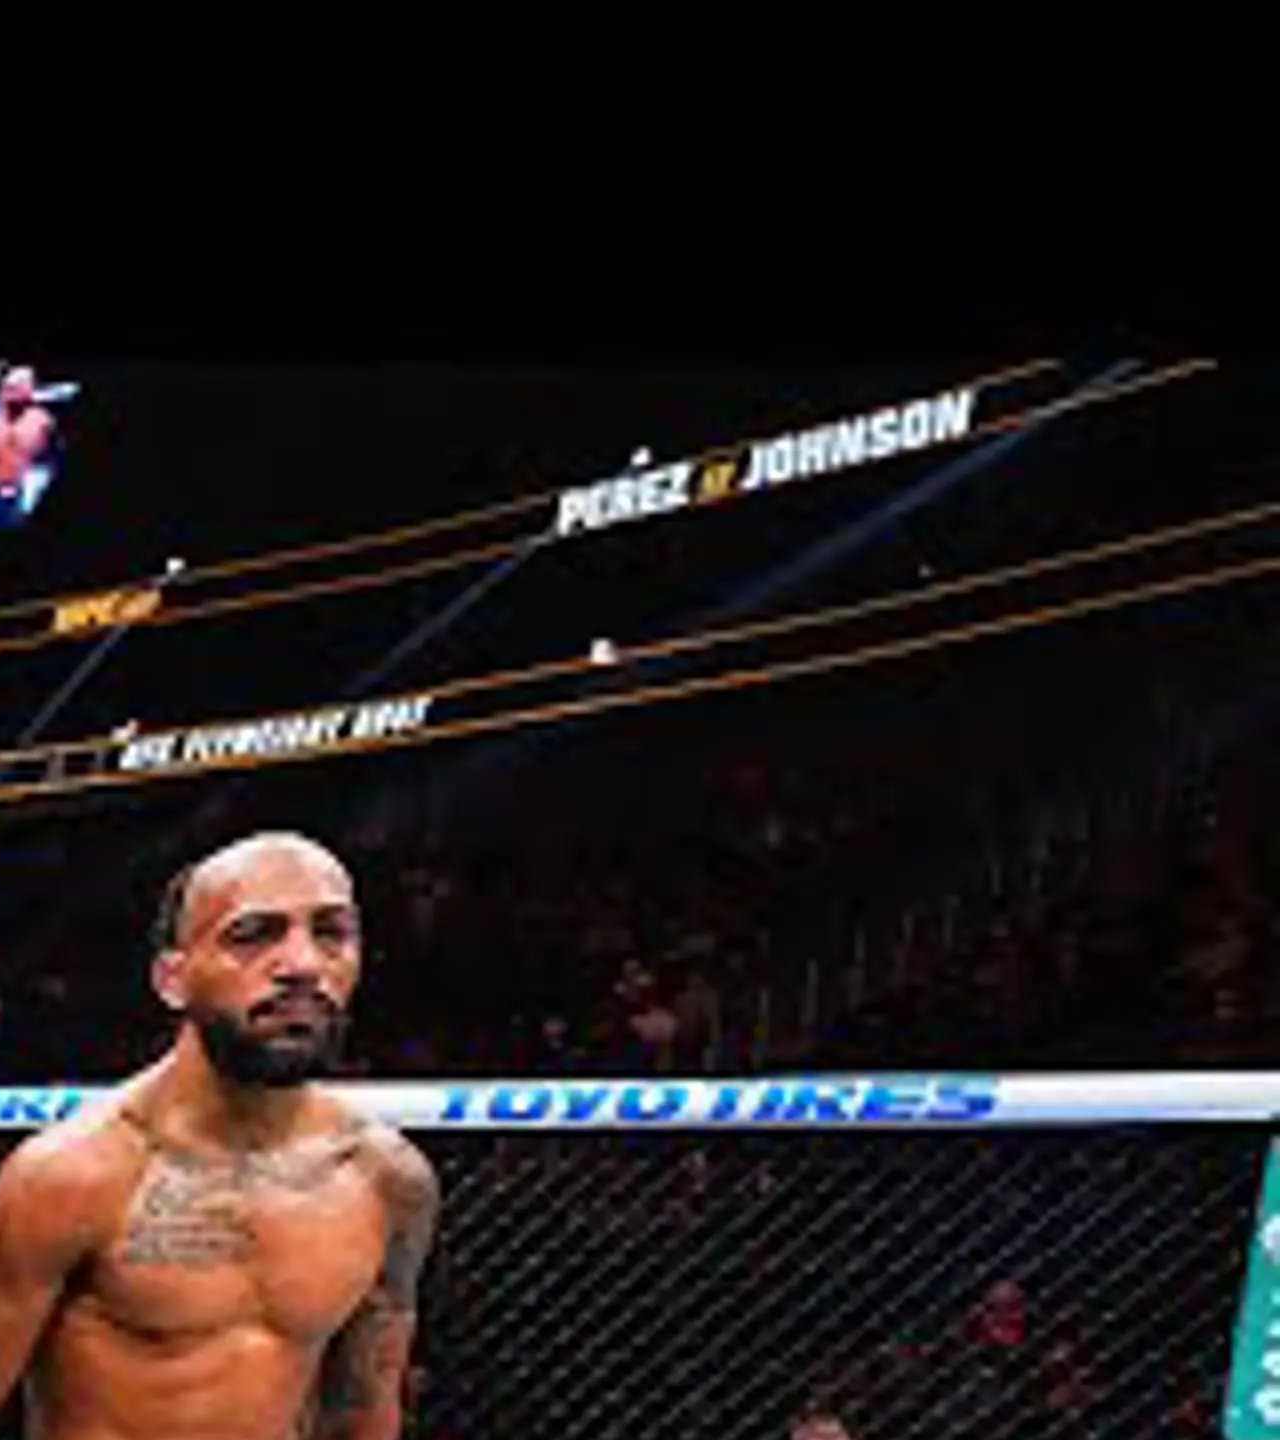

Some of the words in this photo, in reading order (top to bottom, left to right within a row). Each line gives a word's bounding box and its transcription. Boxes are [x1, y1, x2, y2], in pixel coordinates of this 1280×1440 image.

[556, 460, 696, 538] PEREZ
[740, 388, 978, 492] JOHNSON
[440, 1084, 652, 1122] TOYO
[704, 1076, 998, 1121] TIRES
